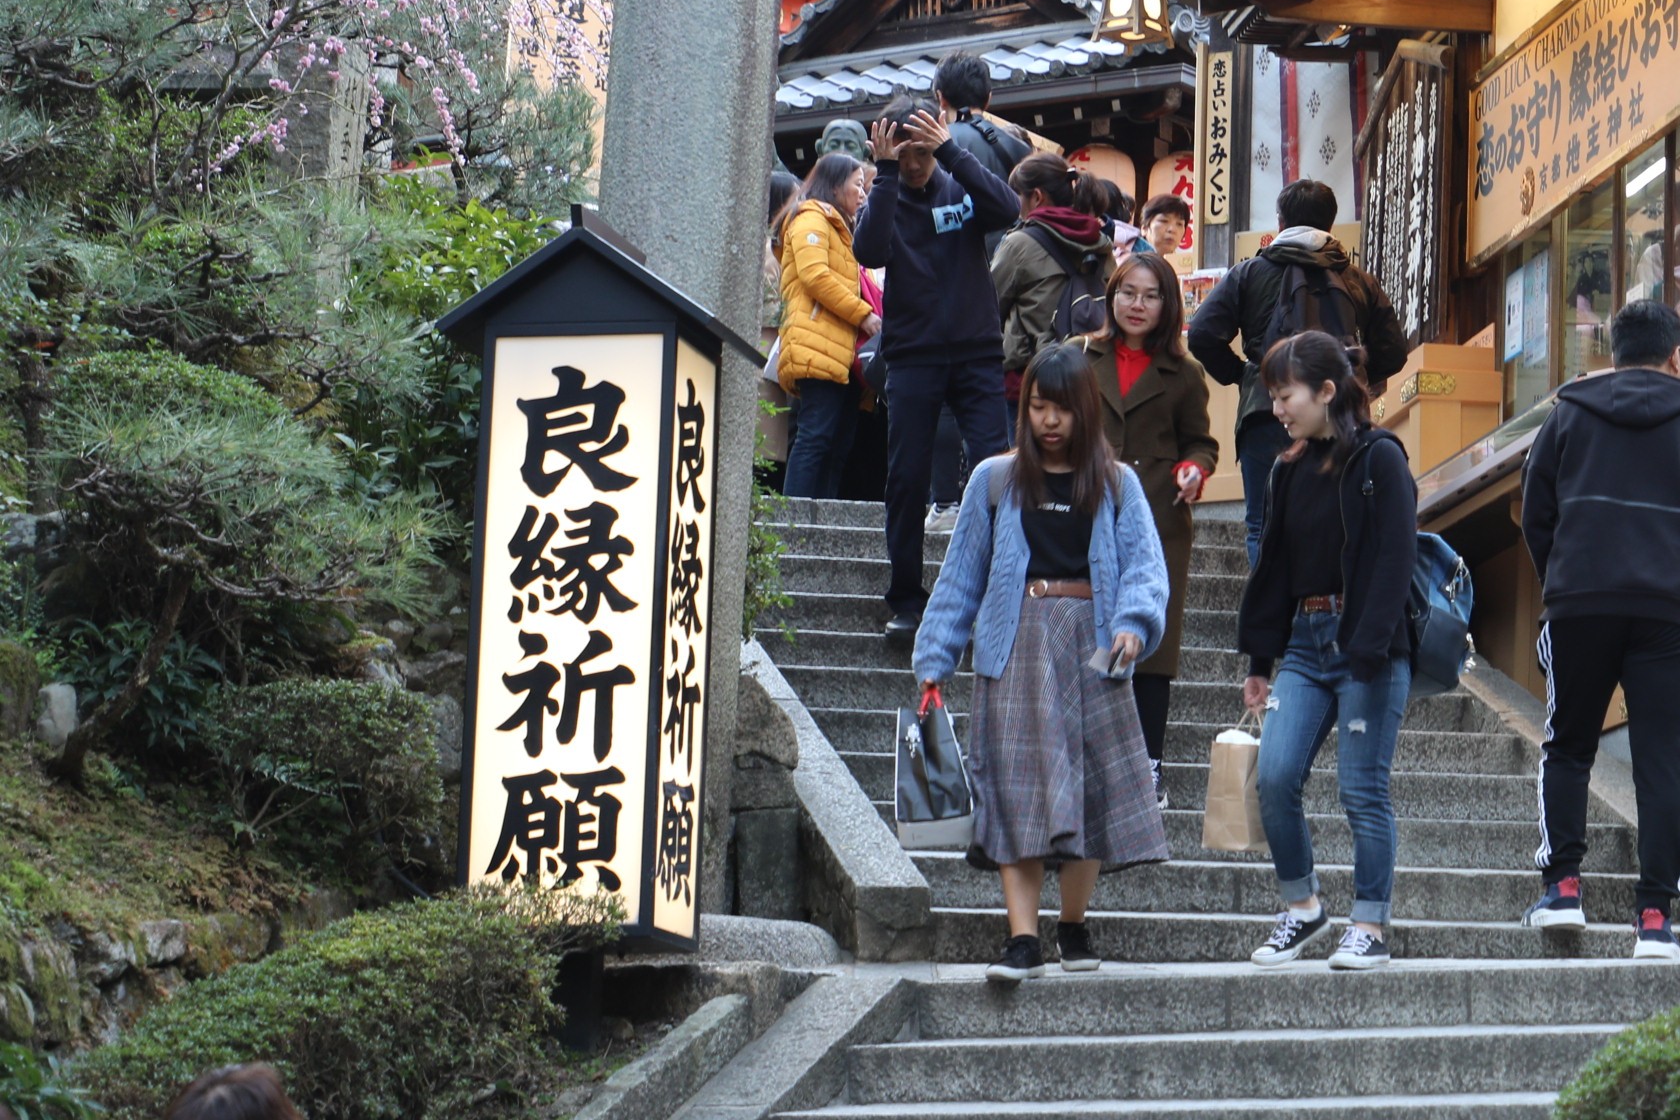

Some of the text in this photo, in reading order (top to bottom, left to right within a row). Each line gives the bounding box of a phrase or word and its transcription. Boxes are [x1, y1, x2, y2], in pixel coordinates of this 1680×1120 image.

[1208, 58, 1228, 217] 恋占いおみくじ
[1475, 75, 1500, 122] GOOD
[1503, 49, 1531, 99] LUCK
[1534, 10, 1580, 72] CHARMS
[1475, 69, 1562, 201] 恋のお守り
[486, 364, 640, 894] 良縁祈願
[655, 377, 707, 908] 良縁祈願
